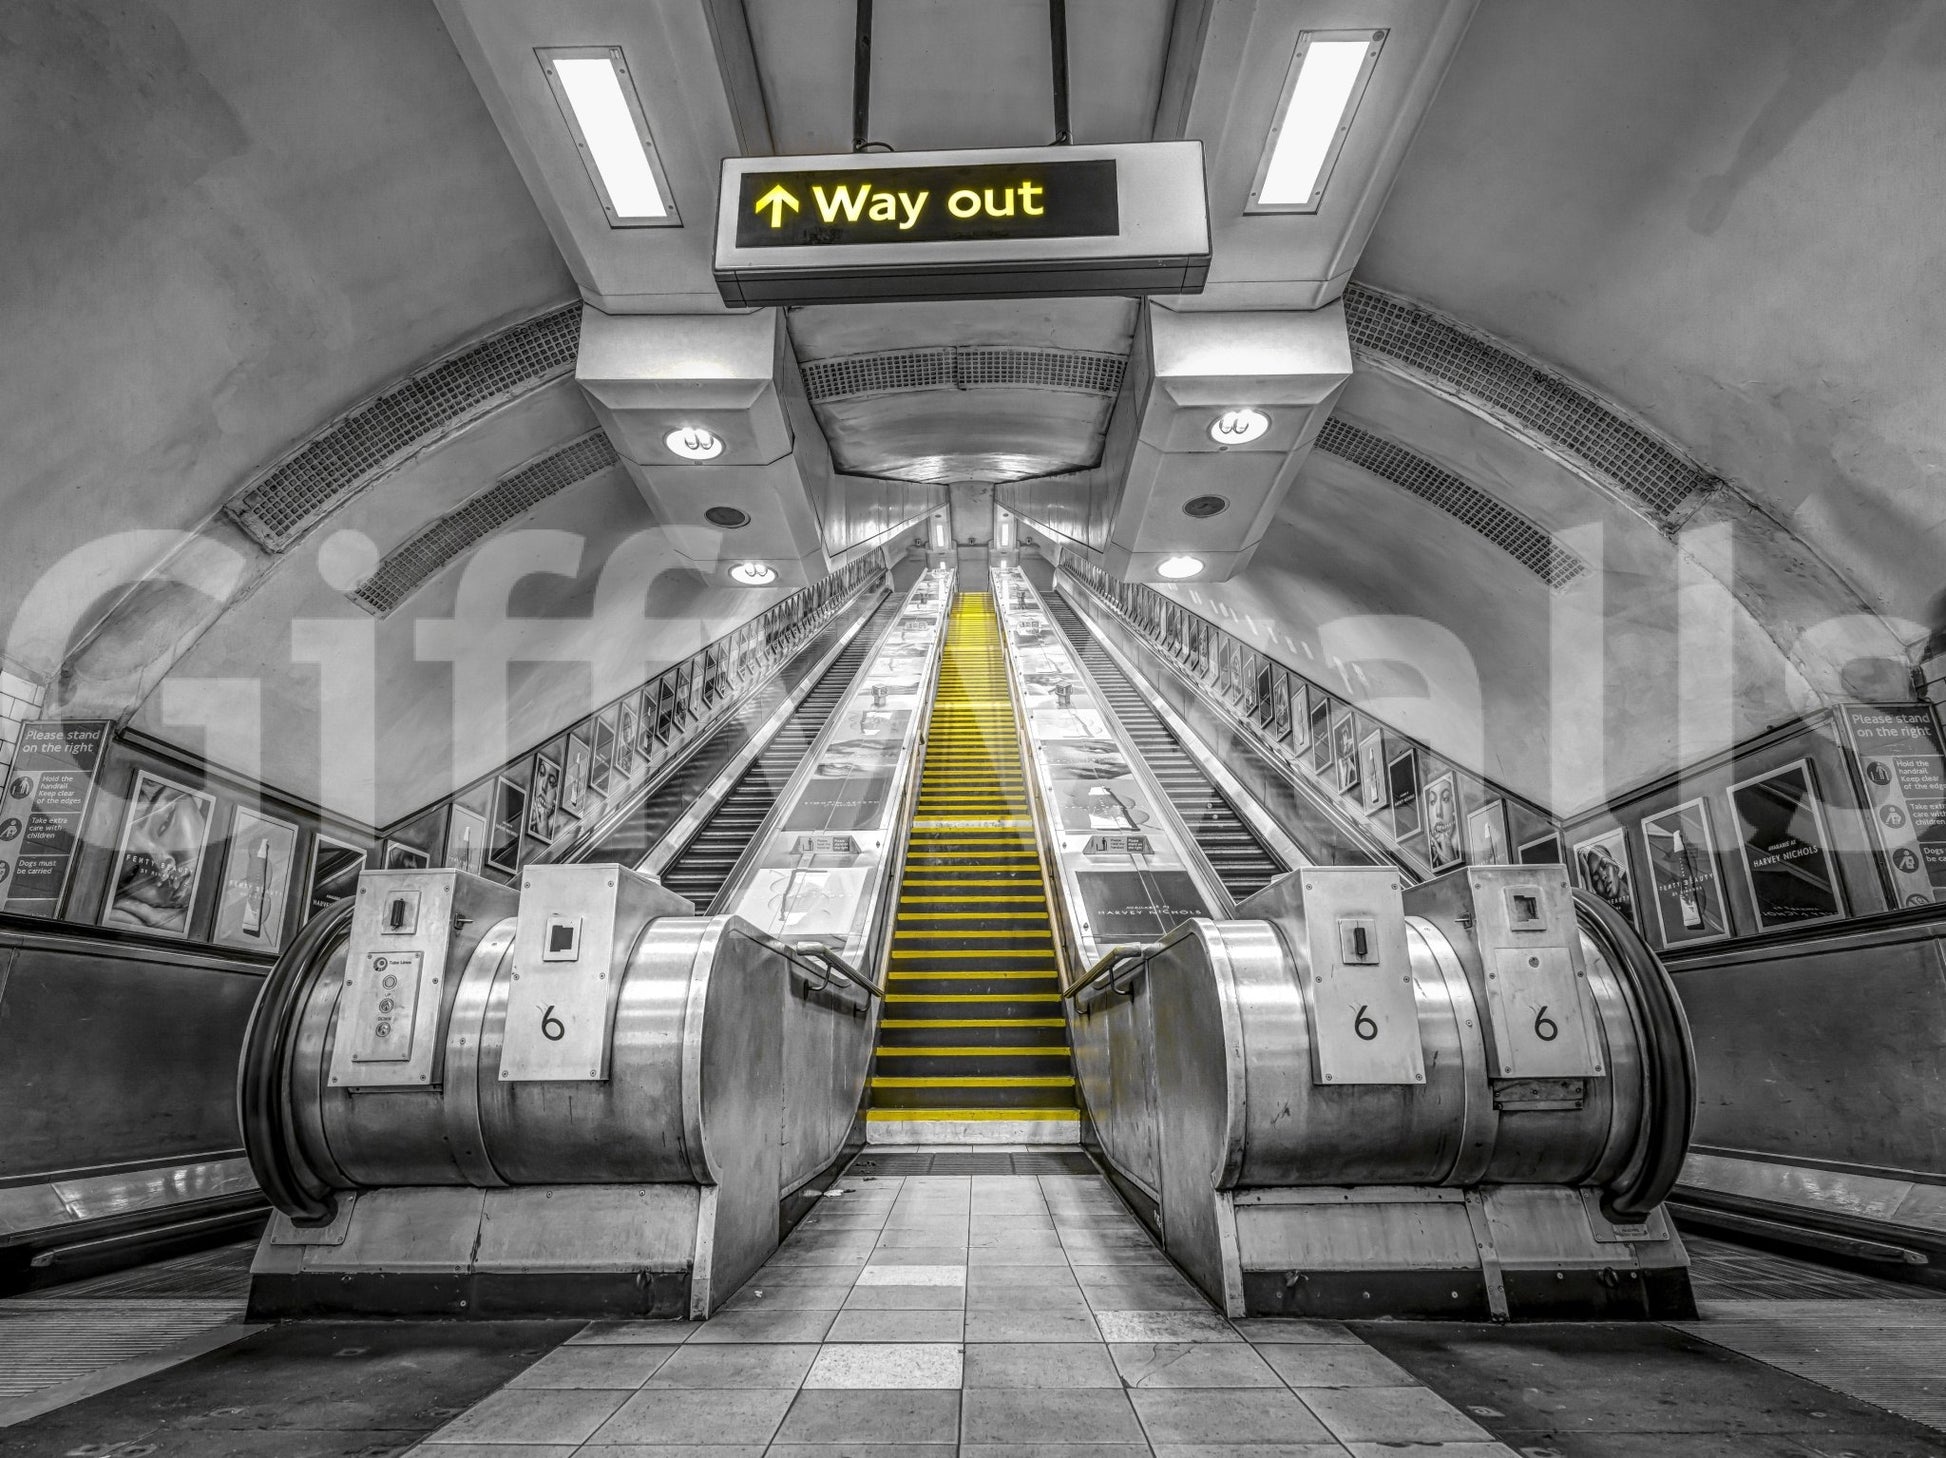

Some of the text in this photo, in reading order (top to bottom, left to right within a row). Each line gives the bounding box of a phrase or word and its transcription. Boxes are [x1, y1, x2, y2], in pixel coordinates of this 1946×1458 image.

[812, 181, 1044, 230] Way out
[1852, 713, 1931, 724] Please stand
[25, 729, 101, 741] Please stand
[1857, 725, 1932, 739] on the right
[22, 742, 94, 755] on the right
[1901, 775, 1919, 783] Keep
[60, 798, 81, 806] edges
[1915, 818, 1946, 826] children
[27, 831, 55, 839] children
[1753, 845, 1819, 868] HARVEY NICHOLS
[1923, 847, 1944, 856] Dogs
[19, 859, 37, 868] Dogs
[126, 854, 155, 867] FENTY
[16, 867, 27, 875] be
[541, 1005, 565, 1041] 6
[1354, 1005, 1378, 1041] 6
[1534, 1005, 1558, 1041] 6
